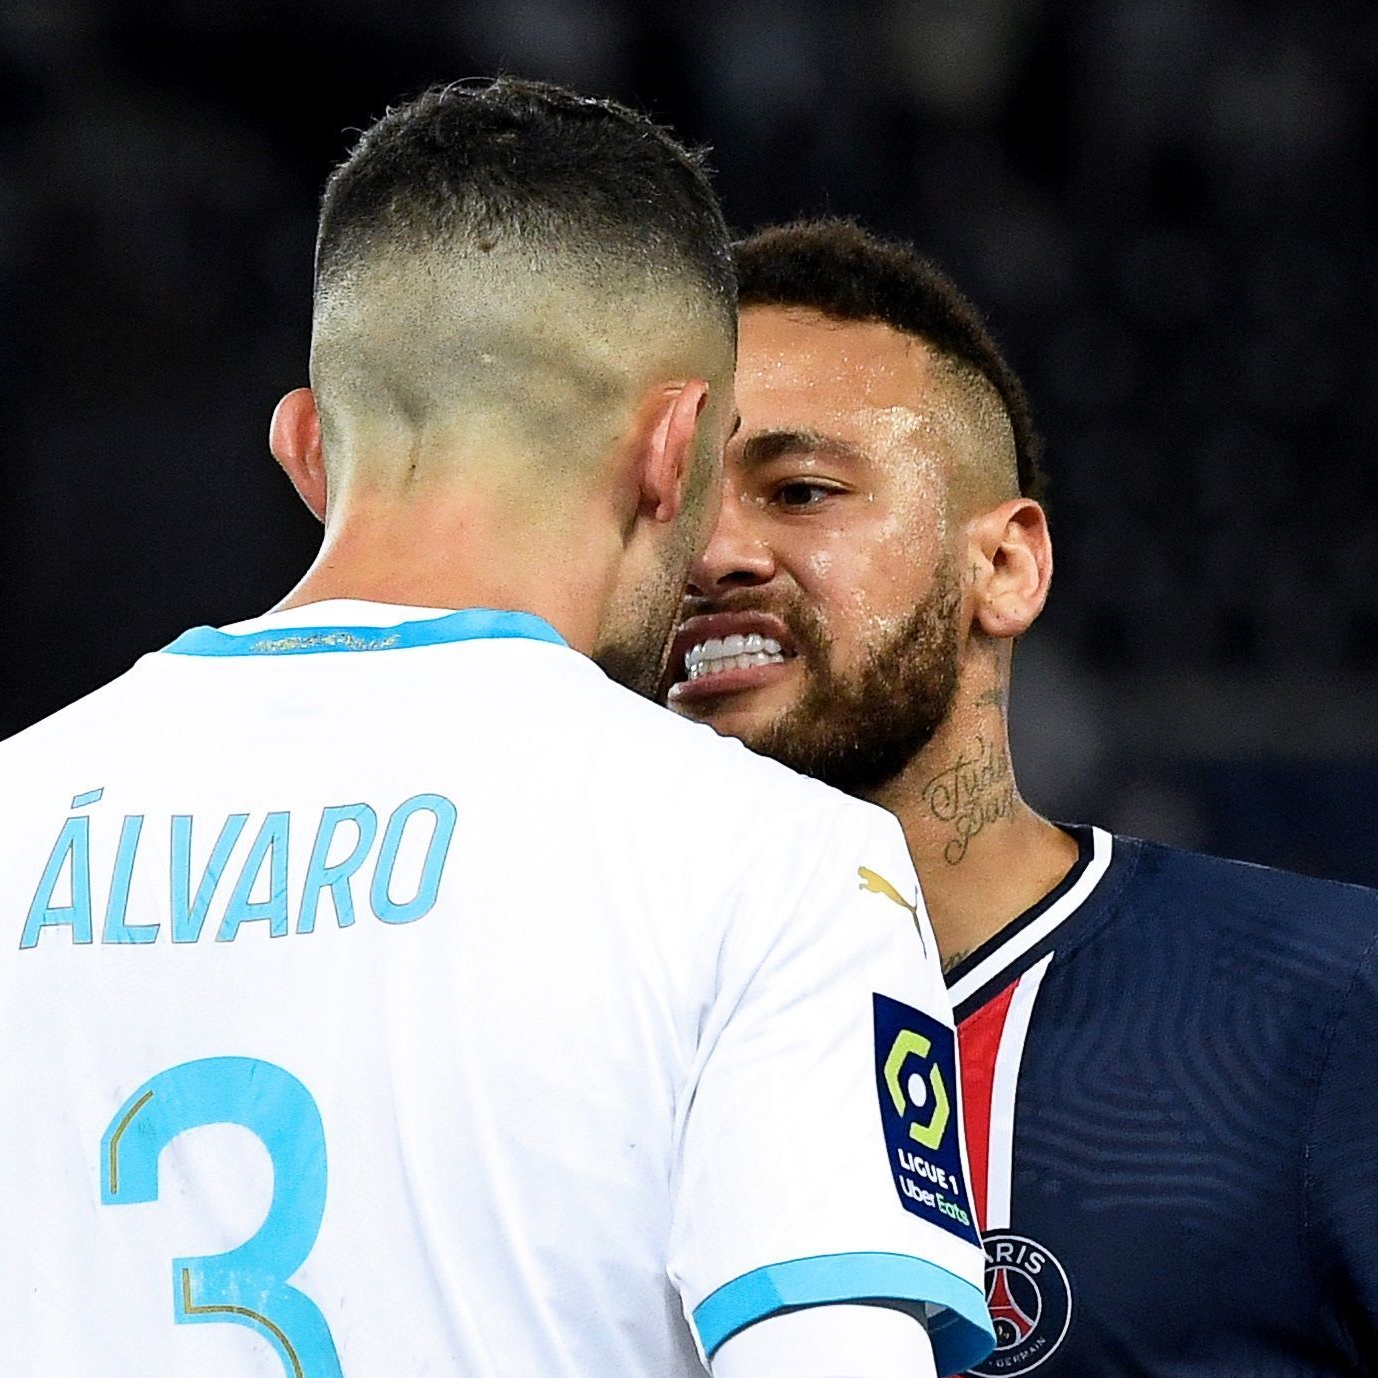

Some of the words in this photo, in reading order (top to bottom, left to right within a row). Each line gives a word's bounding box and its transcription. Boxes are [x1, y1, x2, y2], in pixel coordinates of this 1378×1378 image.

[19, 787, 458, 949] ÁLVARO
[897, 1148, 949, 1190] LIGUE
[949, 1175, 959, 1195] 1
[899, 1174, 936, 1208] Uber
[936, 1192, 971, 1227] Eats
[985, 1242, 1046, 1274] RIS
